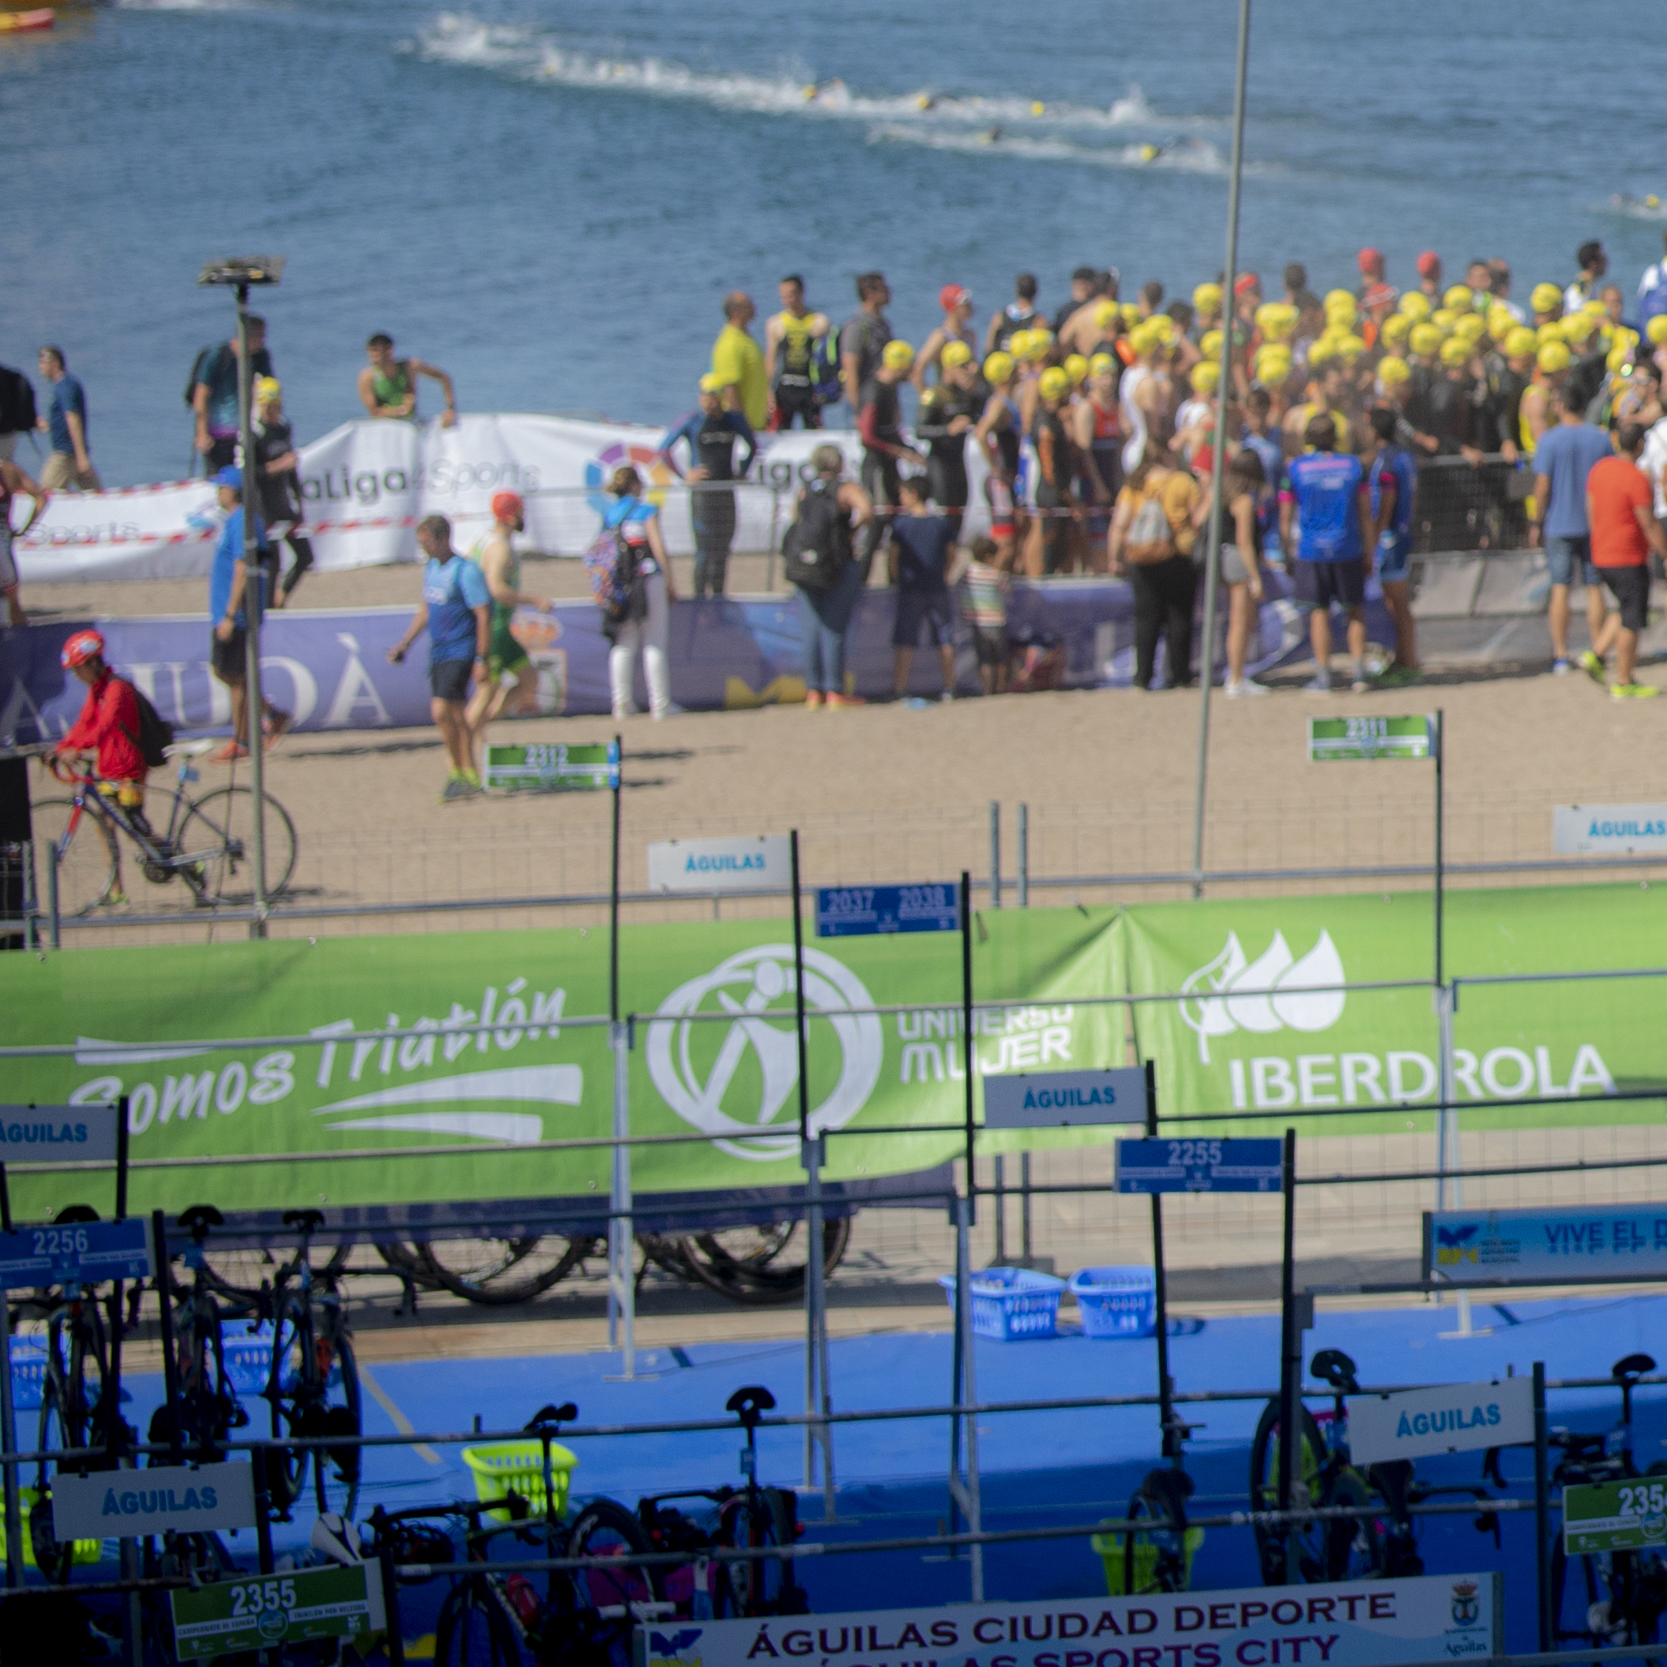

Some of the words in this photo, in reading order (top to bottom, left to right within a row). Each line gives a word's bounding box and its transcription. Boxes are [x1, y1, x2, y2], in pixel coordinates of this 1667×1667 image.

[525, 746, 568, 765] 2312
[1588, 818, 1667, 836] ÁGUILAS
[684, 851, 766, 874] ÁGUILAS
[311, 978, 566, 1089] Triatlón
[902, 1026, 1072, 1082] MUJER
[1231, 1043, 1616, 1109] IBERDROLA
[1023, 1086, 1115, 1109] ÁGUILAS
[1168, 1141, 1222, 1165] 2255
[33, 1228, 88, 1255] 2256
[1544, 1221, 1604, 1243] VIVE
[1613, 1220, 1646, 1240] EL
[1395, 1404, 1501, 1437] ÁGUILAS
[102, 1486, 218, 1516] ÁGUILAS
[230, 1579, 297, 1616] 2355
[747, 1623, 958, 1659] ÁGUILAS
[973, 1608, 1158, 1644] CIUDAD
[1173, 1592, 1397, 1633] DEPORTE
[1236, 1635, 1340, 1666] CITY
